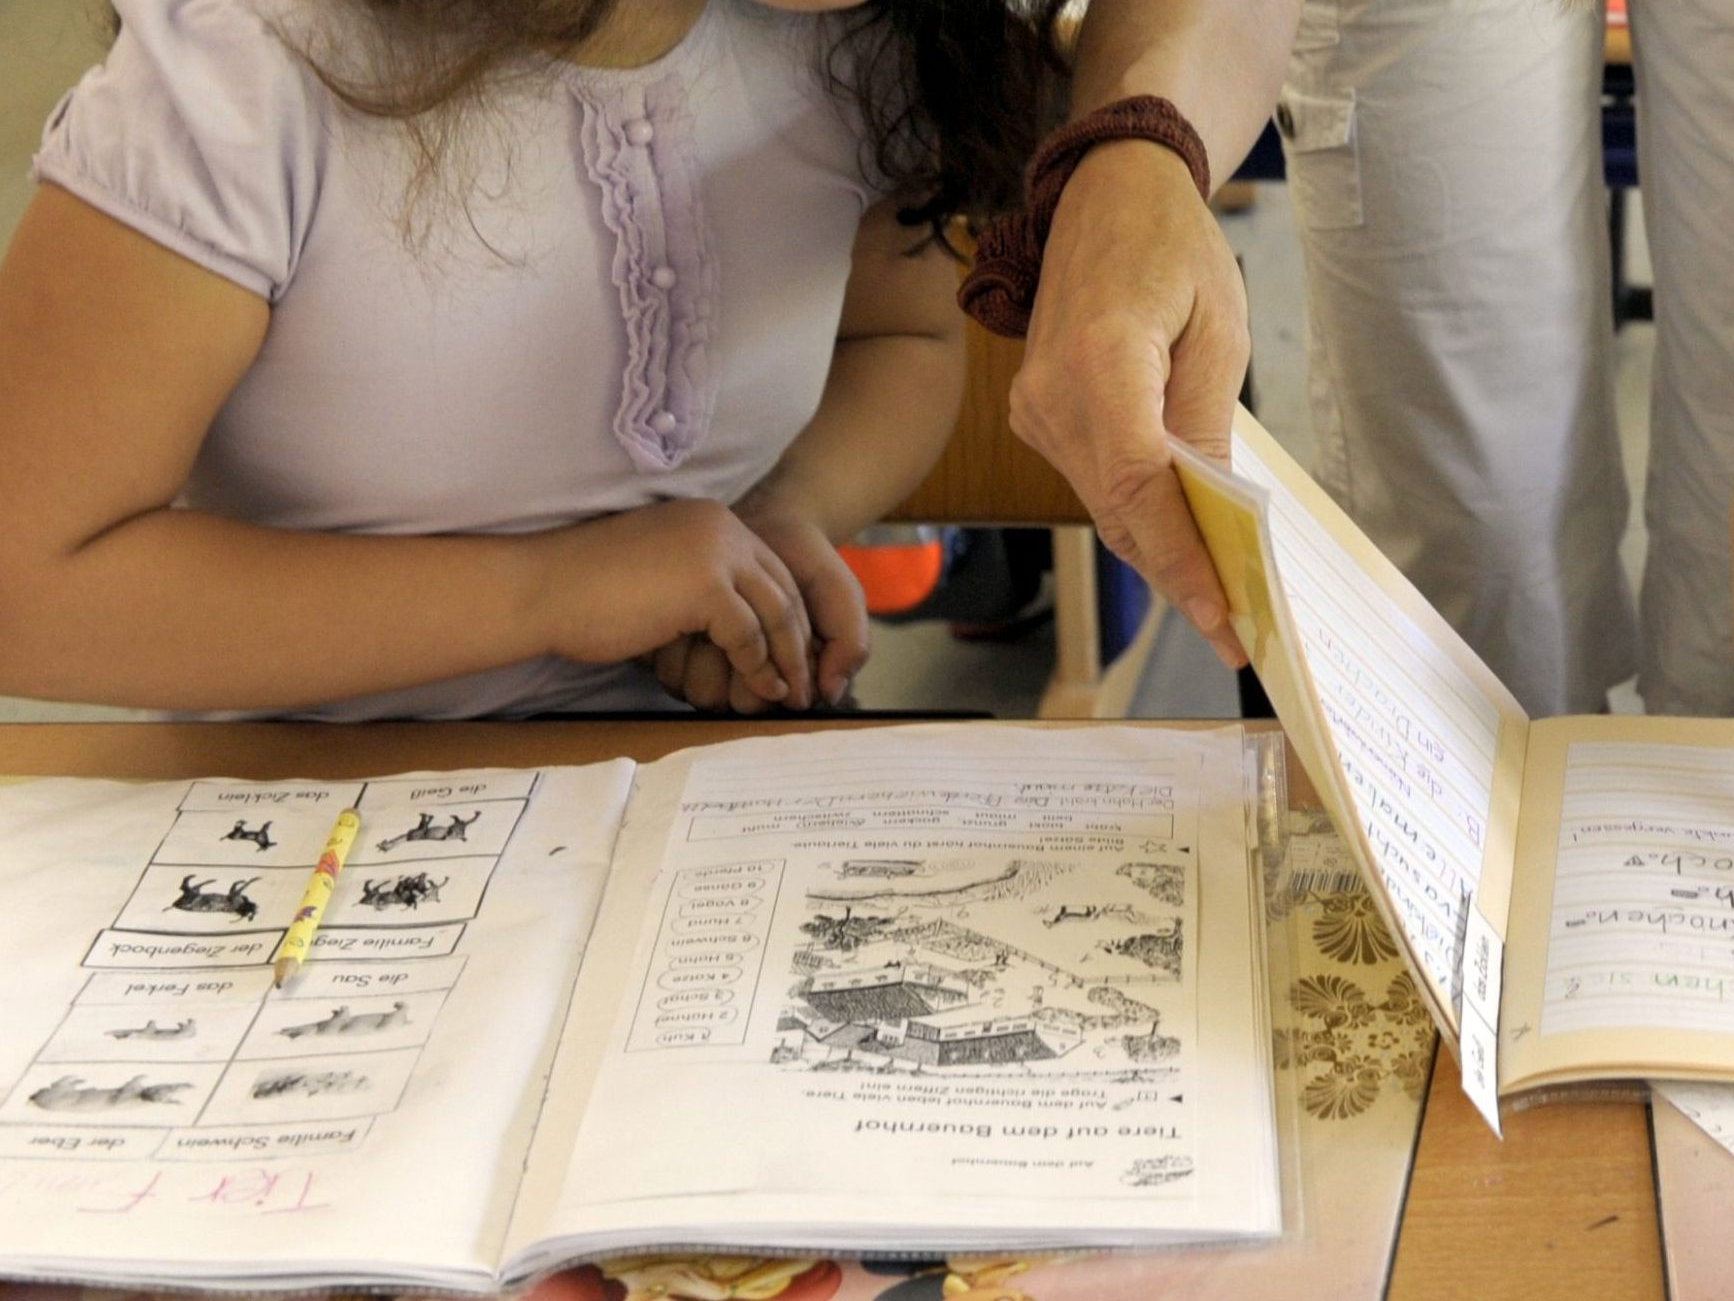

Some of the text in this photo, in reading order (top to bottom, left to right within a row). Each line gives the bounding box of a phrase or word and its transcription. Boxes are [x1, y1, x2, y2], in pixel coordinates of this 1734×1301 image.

[1334, 683, 1408, 772] Kinder
[1416, 764, 1444, 801] die
[217, 790, 330, 805] das Zicklein
[410, 782, 486, 800] die Geiß
[1570, 820, 1674, 844] vergessen!
[864, 841, 898, 850] viele
[969, 841, 1045, 852] Bauernhof
[694, 865, 742, 878] Pferde
[688, 918, 729, 927] Hund
[308, 934, 434, 951] Familie Zieg
[671, 934, 737, 947] Schwein
[108, 940, 263, 960] der Ziegenbock
[678, 954, 719, 964] Hahn
[331, 972, 409, 988] die Sau
[672, 974, 716, 983] Katze
[124, 981, 234, 997] das Ferkel
[663, 993, 709, 1004] Schaf
[662, 1033, 694, 1042] Kuh
[859, 1082, 1107, 1099] Trage die richtigen Ziffern ein!
[800, 1090, 1107, 1110] Auf dem Bauernhof leben viele Tiere.
[853, 1119, 1182, 1140] Tiere auf dem Bauernhof
[26, 1136, 125, 1151] der Eber
[176, 1129, 356, 1151] Familie Schwein
[950, 1157, 1094, 1169] Auf dem Bauernhof
